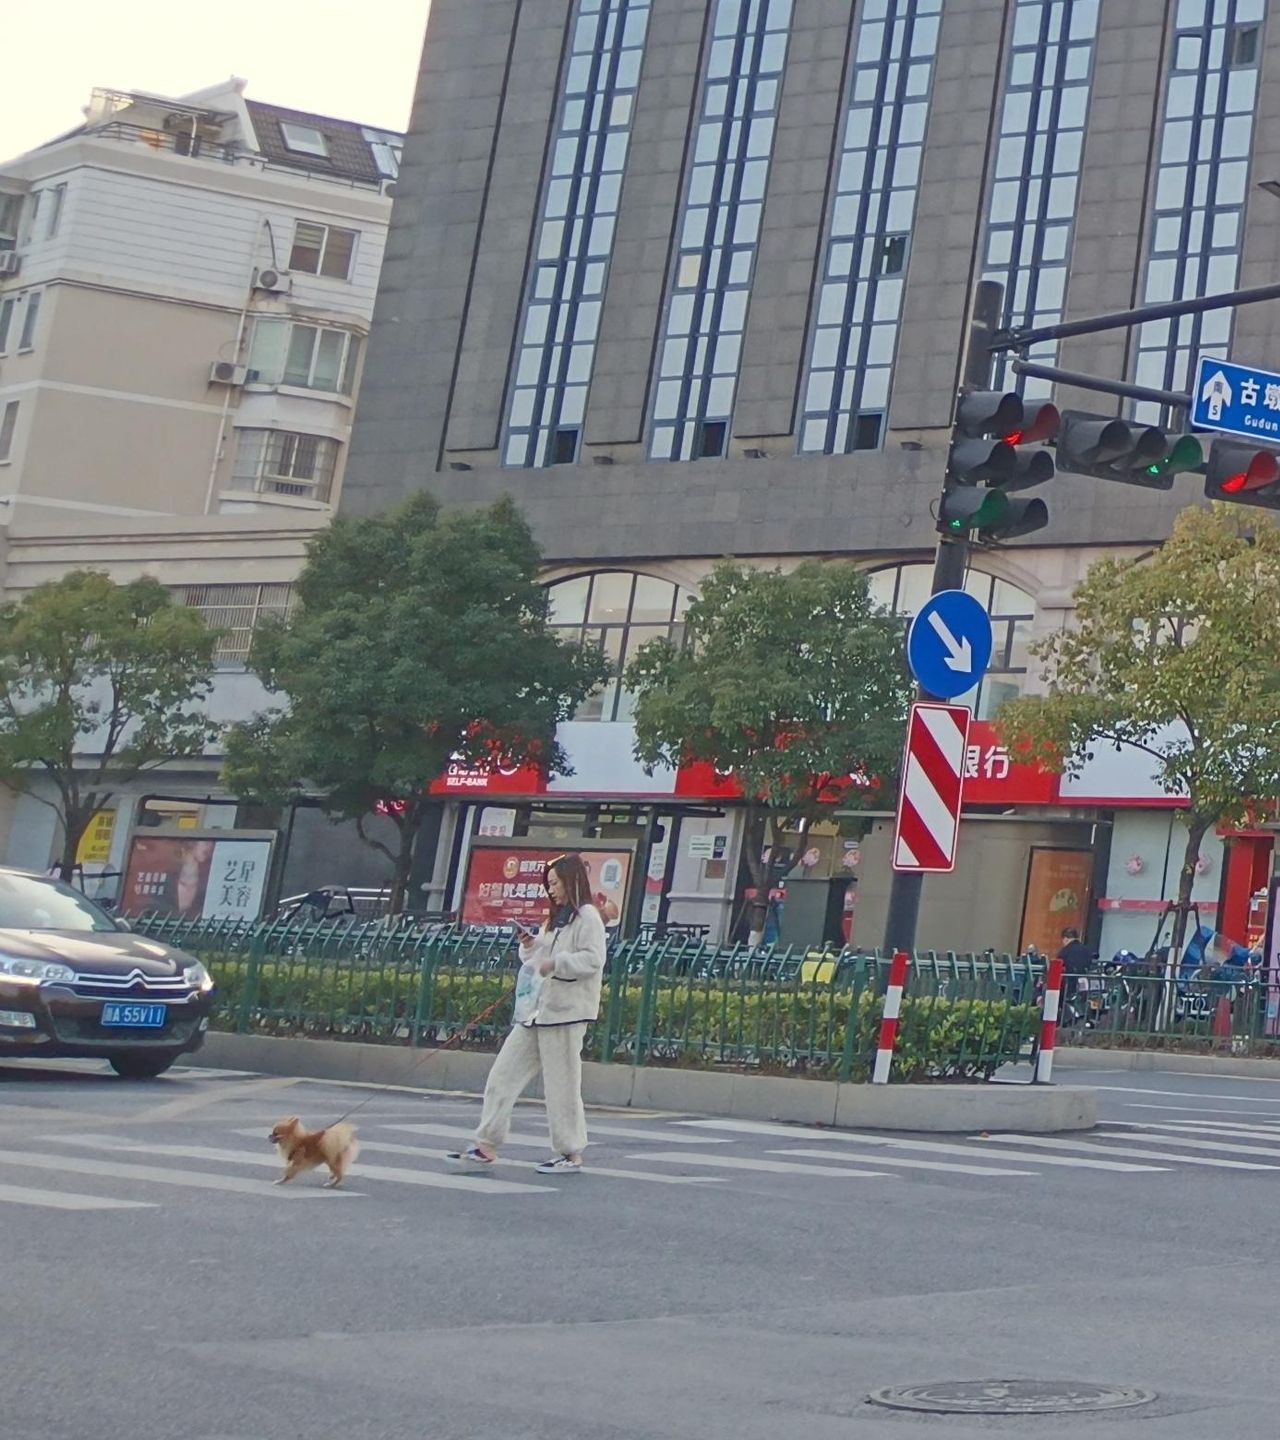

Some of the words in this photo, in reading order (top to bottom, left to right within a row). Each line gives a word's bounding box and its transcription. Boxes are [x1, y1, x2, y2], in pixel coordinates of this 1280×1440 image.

[1244, 415, 1278, 432] Gudun
[224, 860, 255, 882] 艺星
[219, 885, 250, 907] 美容
